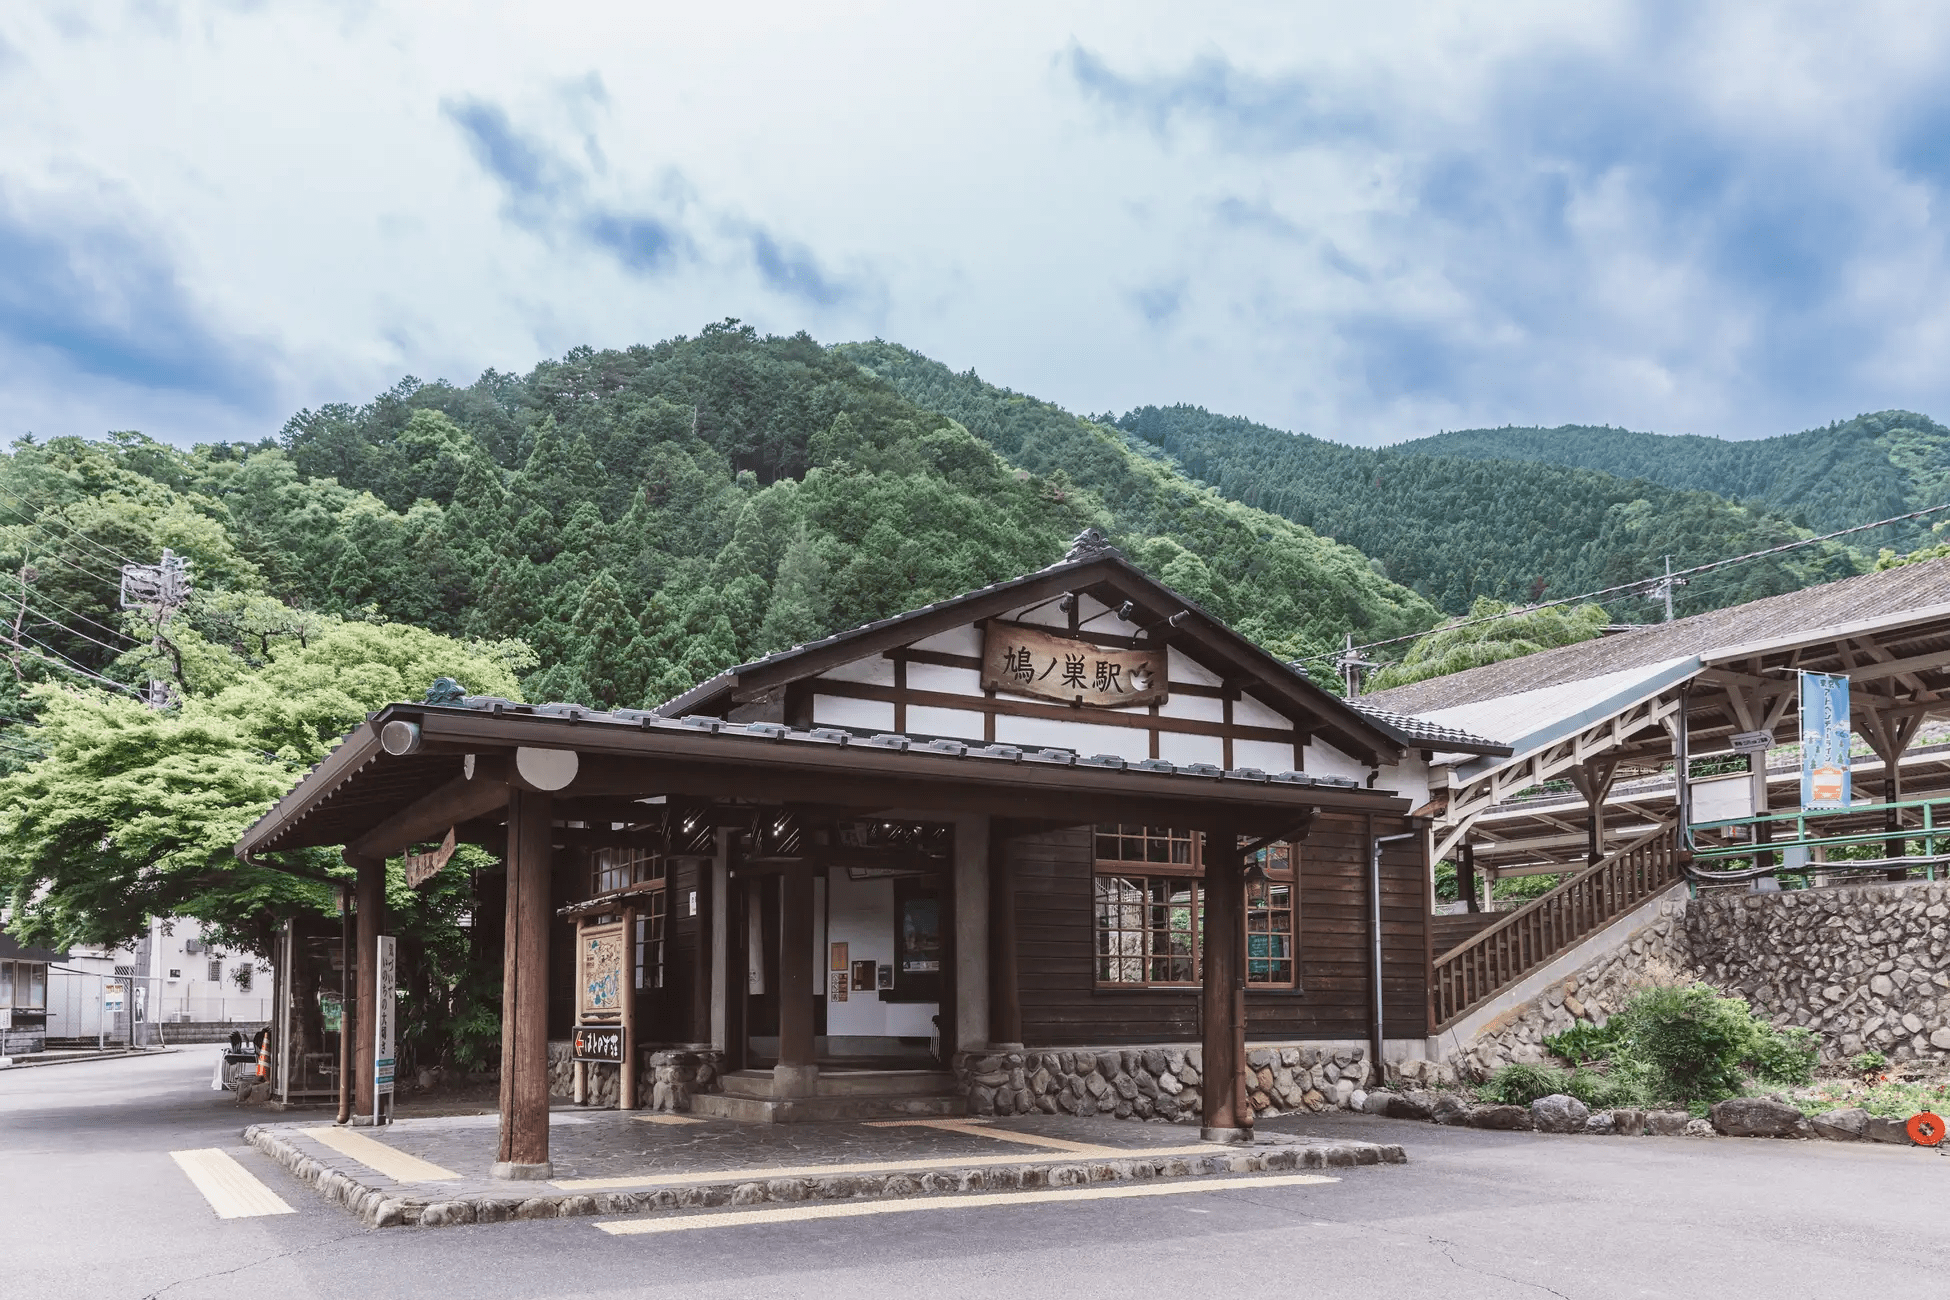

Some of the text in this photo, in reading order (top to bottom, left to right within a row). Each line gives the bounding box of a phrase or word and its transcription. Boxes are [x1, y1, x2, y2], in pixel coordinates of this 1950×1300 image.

[1003, 646, 1124, 692] 鳩ノ巣駅
[1820, 679, 1835, 689] 東京
